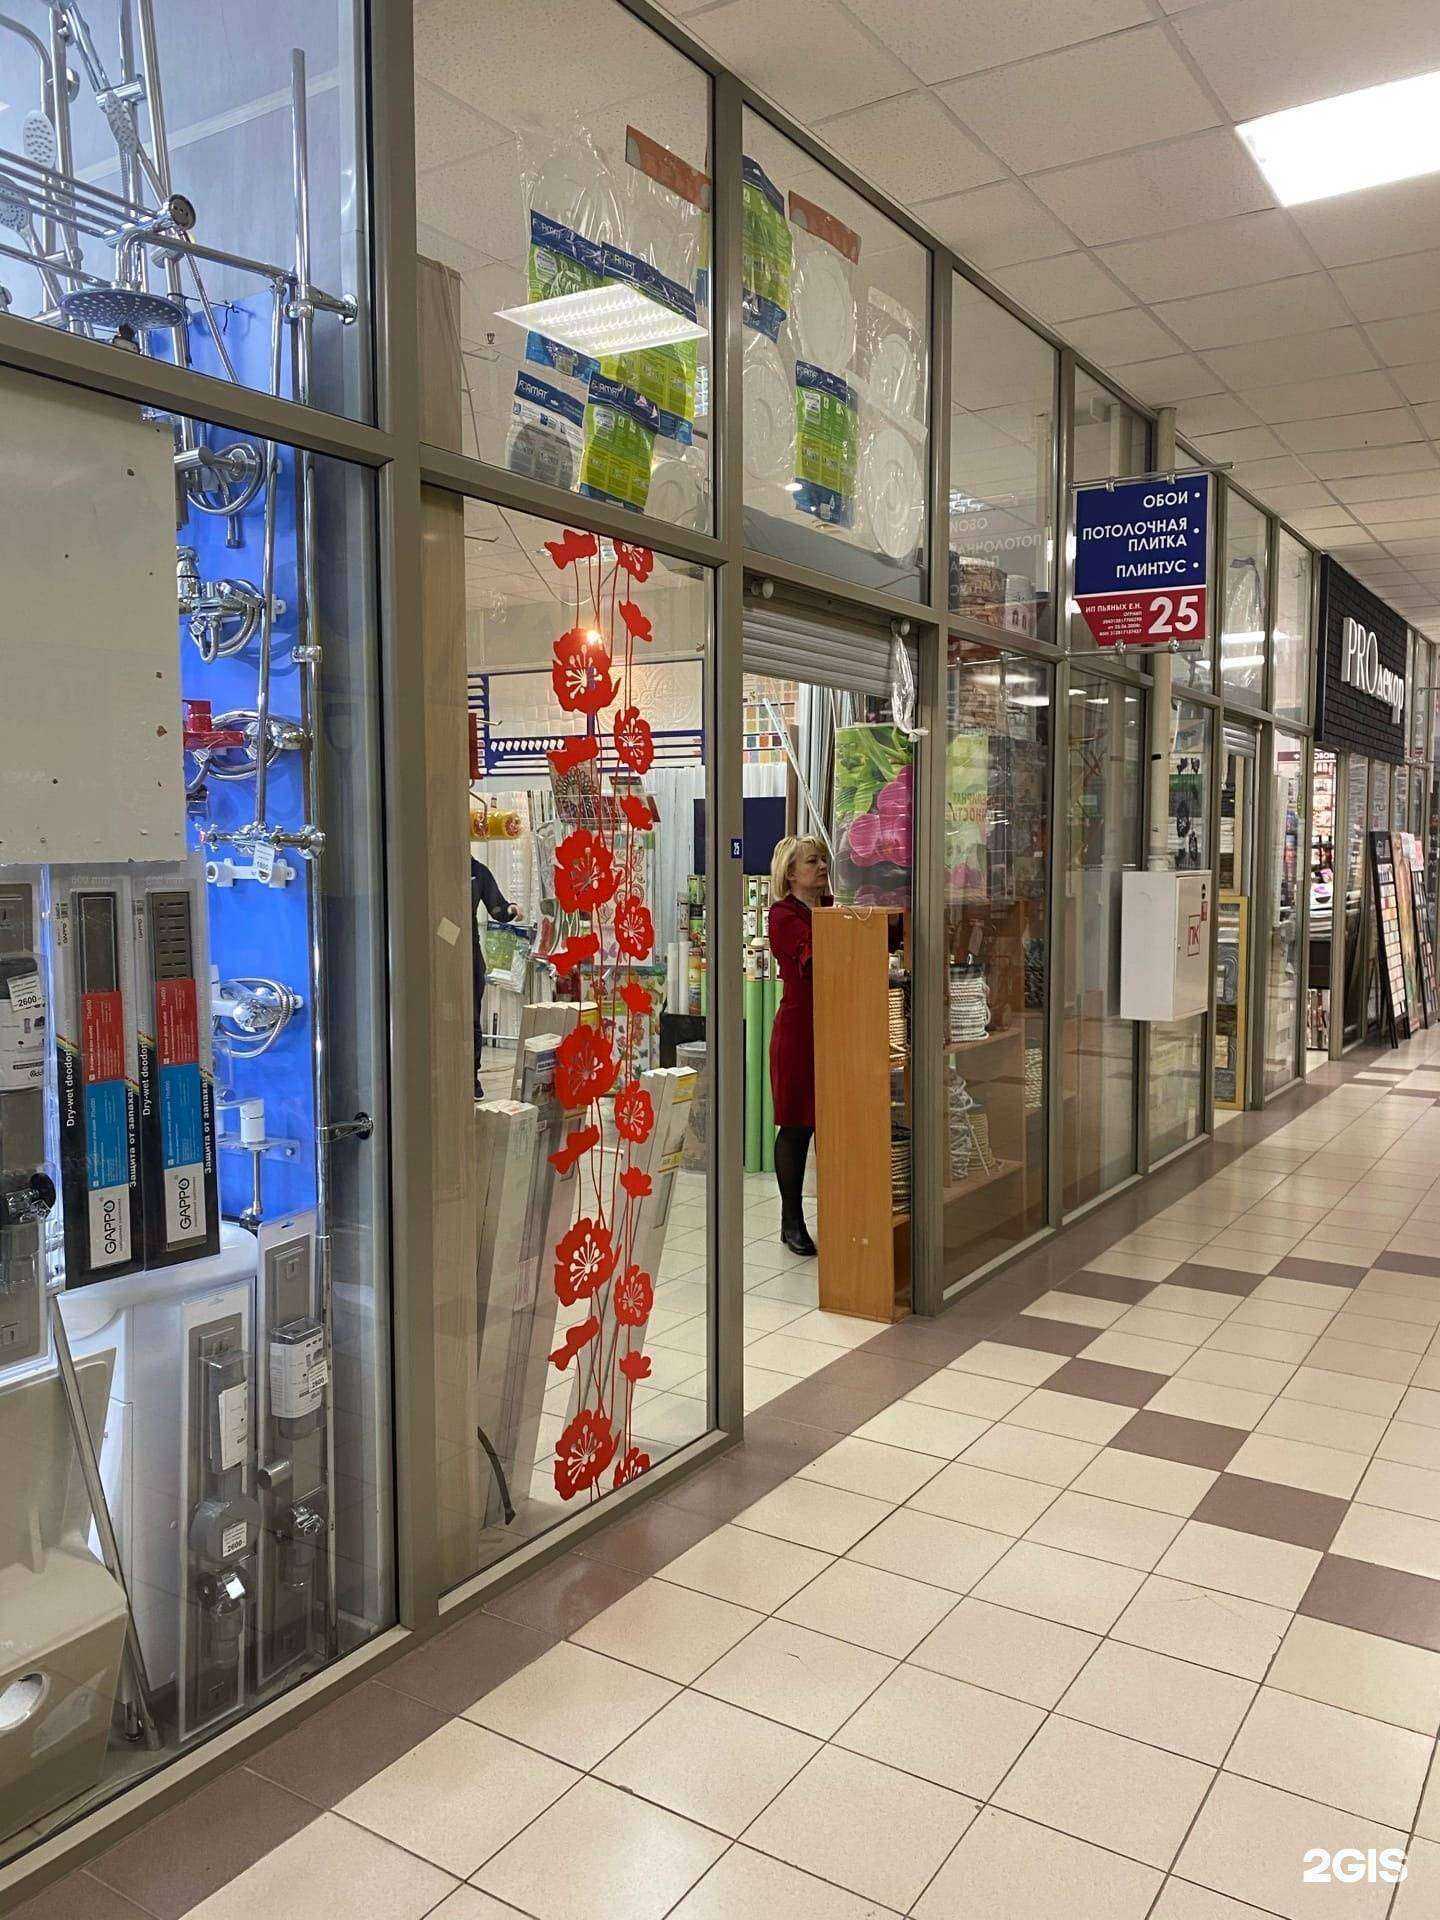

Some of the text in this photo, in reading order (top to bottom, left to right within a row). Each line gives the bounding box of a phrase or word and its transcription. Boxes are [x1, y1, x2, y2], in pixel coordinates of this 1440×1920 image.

[518, 379, 549, 400] FORMAT
[1143, 491, 1188, 509] ОБОИ
[1082, 517, 1187, 541] ПОТОЛОЧНАЯ
[1128, 534, 1187, 552] ПЛИТКА
[1116, 559, 1187, 578] ПЛИНТУС
[1148, 595, 1199, 634] 25
[18, 995, 37, 1007] 2600
[66, 1088, 76, 1127] Dry-wet
[142, 1079, 151, 1116] Dry-wet
[130, 1133, 135, 1145] от
[204, 1121, 210, 1133] от
[129, 1145, 137, 1187] Защита
[204, 1135, 212, 1174] Защита
[177, 1178, 192, 1230] GAPPO
[103, 1199, 117, 1255] GAPPO
